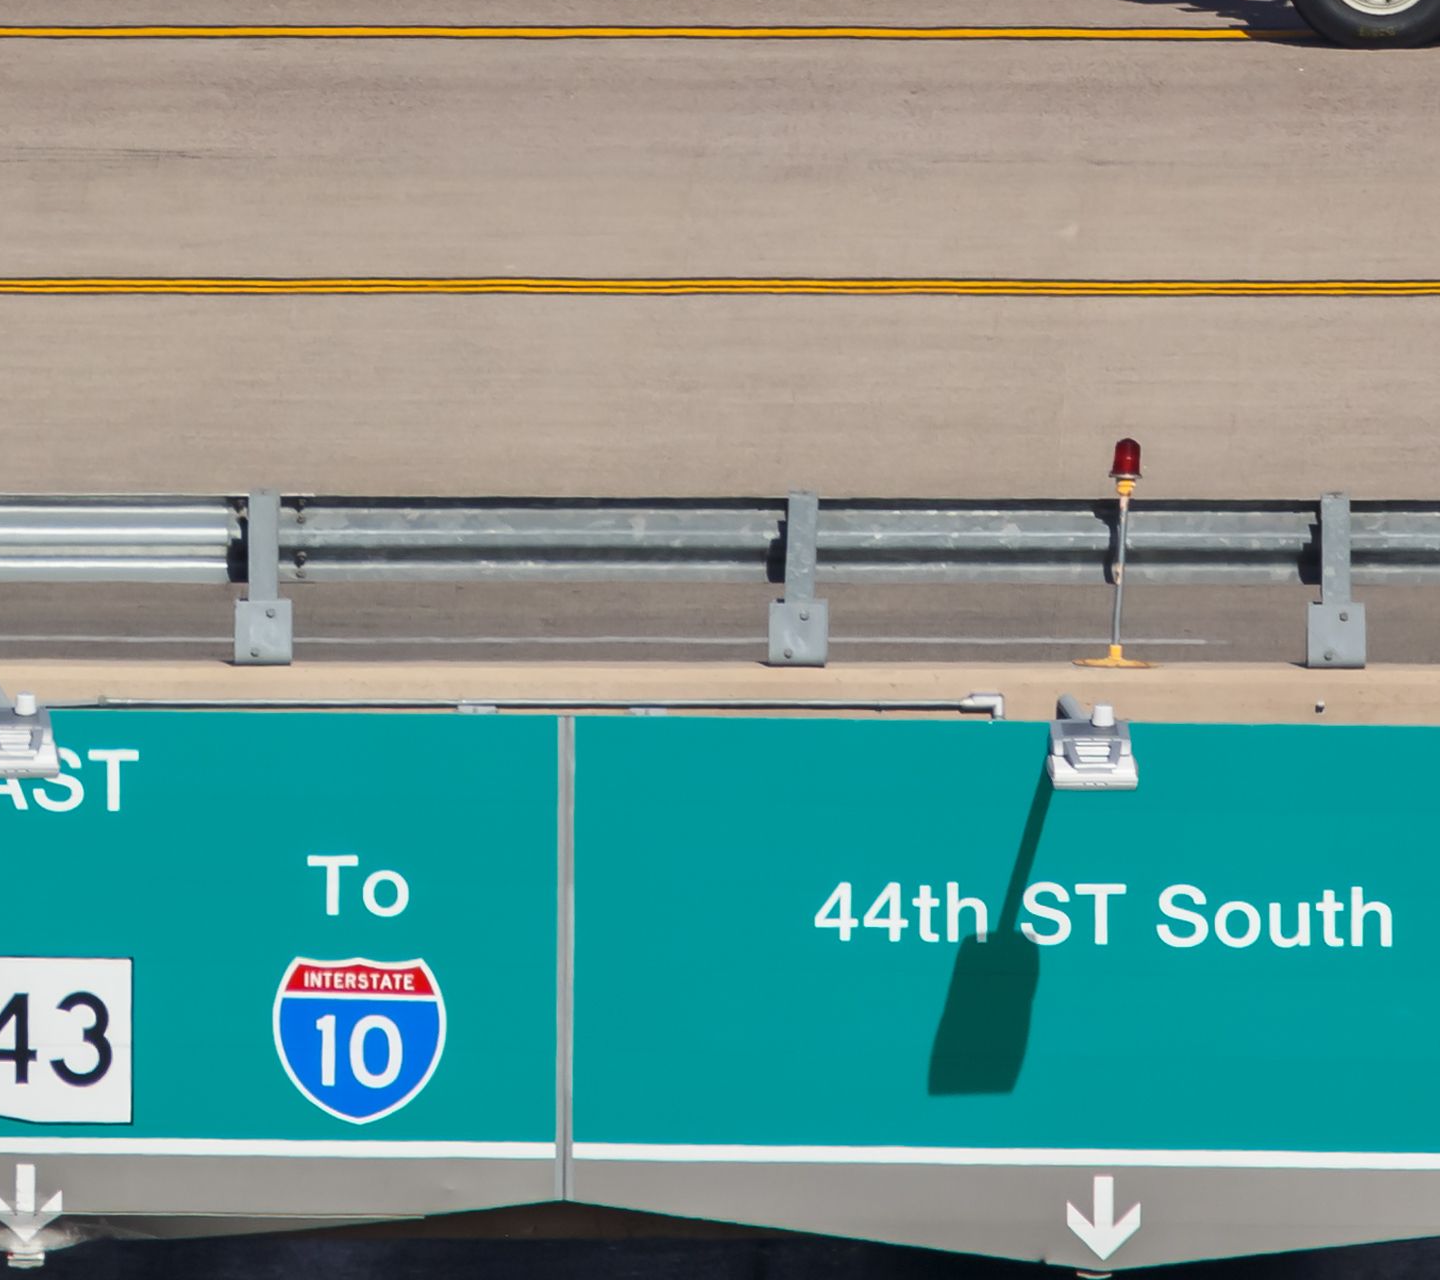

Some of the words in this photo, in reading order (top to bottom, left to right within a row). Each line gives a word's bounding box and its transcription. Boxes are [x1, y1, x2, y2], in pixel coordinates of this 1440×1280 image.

[306, 854, 410, 917] To
[814, 880, 988, 943] 44th
[1020, 881, 1127, 946] ST
[1156, 883, 1394, 948] South
[303, 971, 416, 991] INTERSTATE
[315, 1014, 404, 1089] 10
